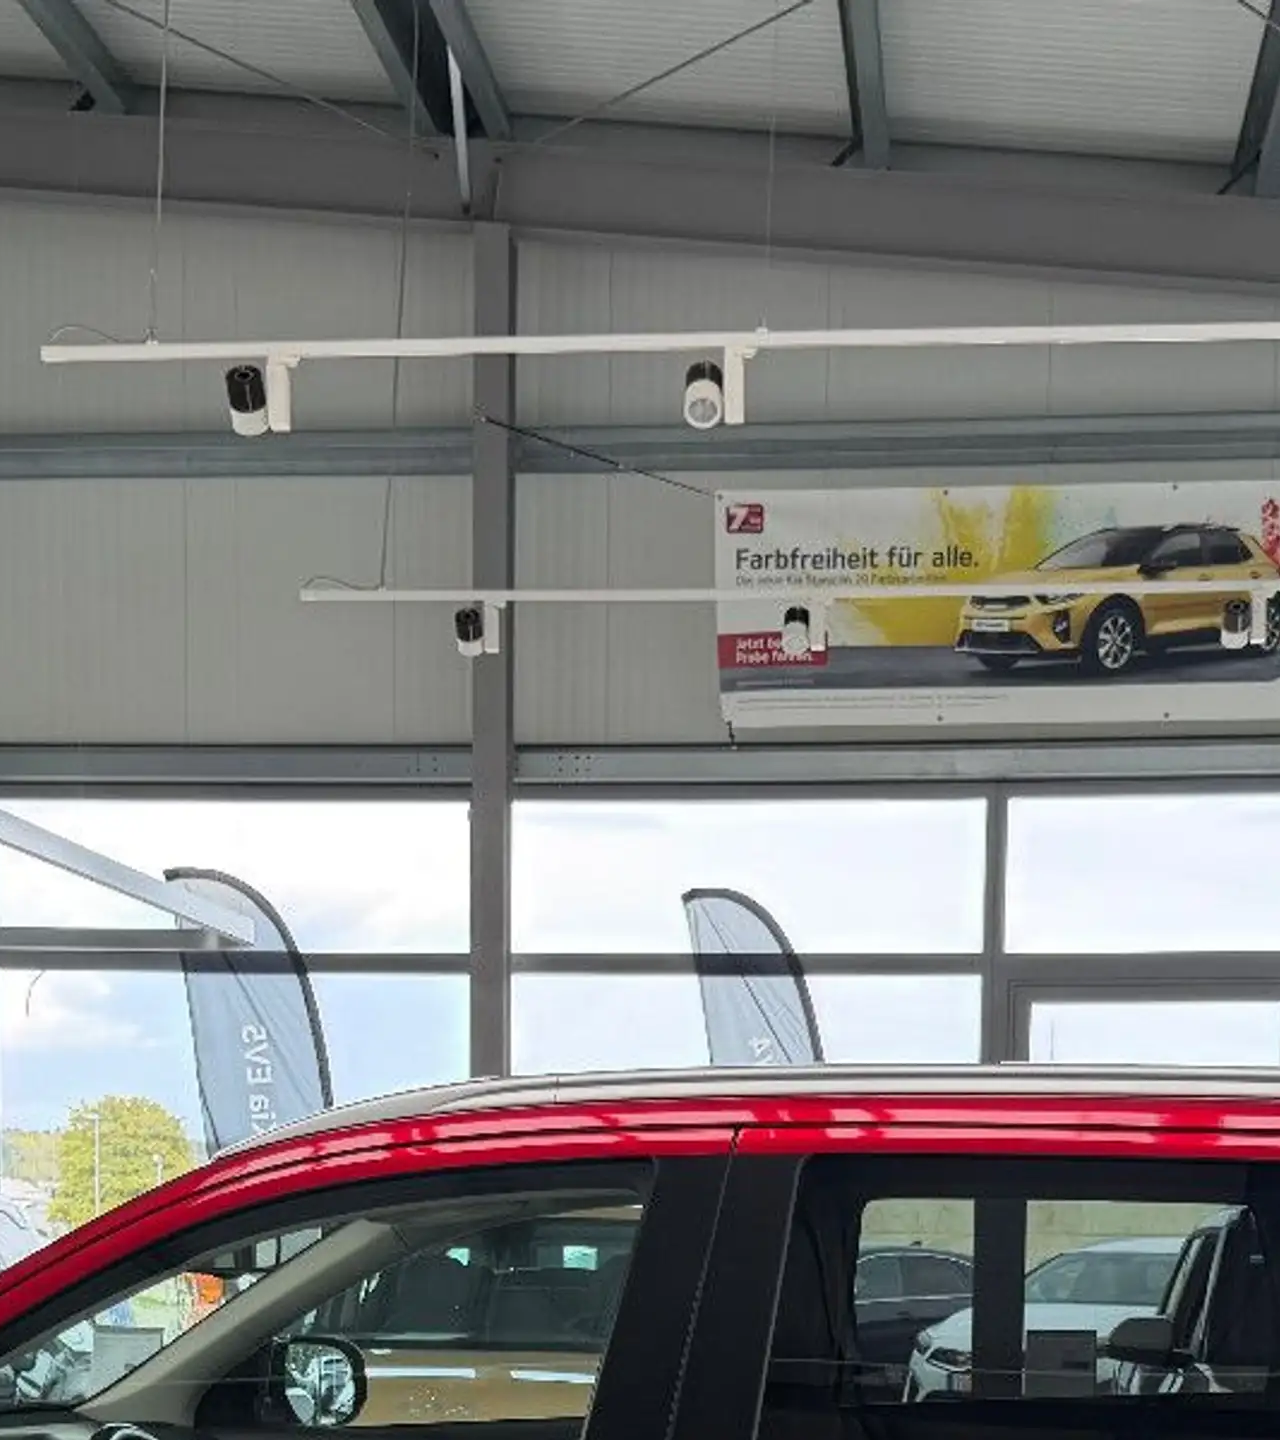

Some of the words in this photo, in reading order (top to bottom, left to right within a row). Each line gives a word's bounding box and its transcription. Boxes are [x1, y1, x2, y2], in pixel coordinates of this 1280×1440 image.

[735, 547, 878, 570] Farbfreiheit
[888, 546, 922, 569] für
[932, 545, 980, 568] alle.
[736, 637, 765, 649] Jetzt
[736, 650, 770, 664] Probe
